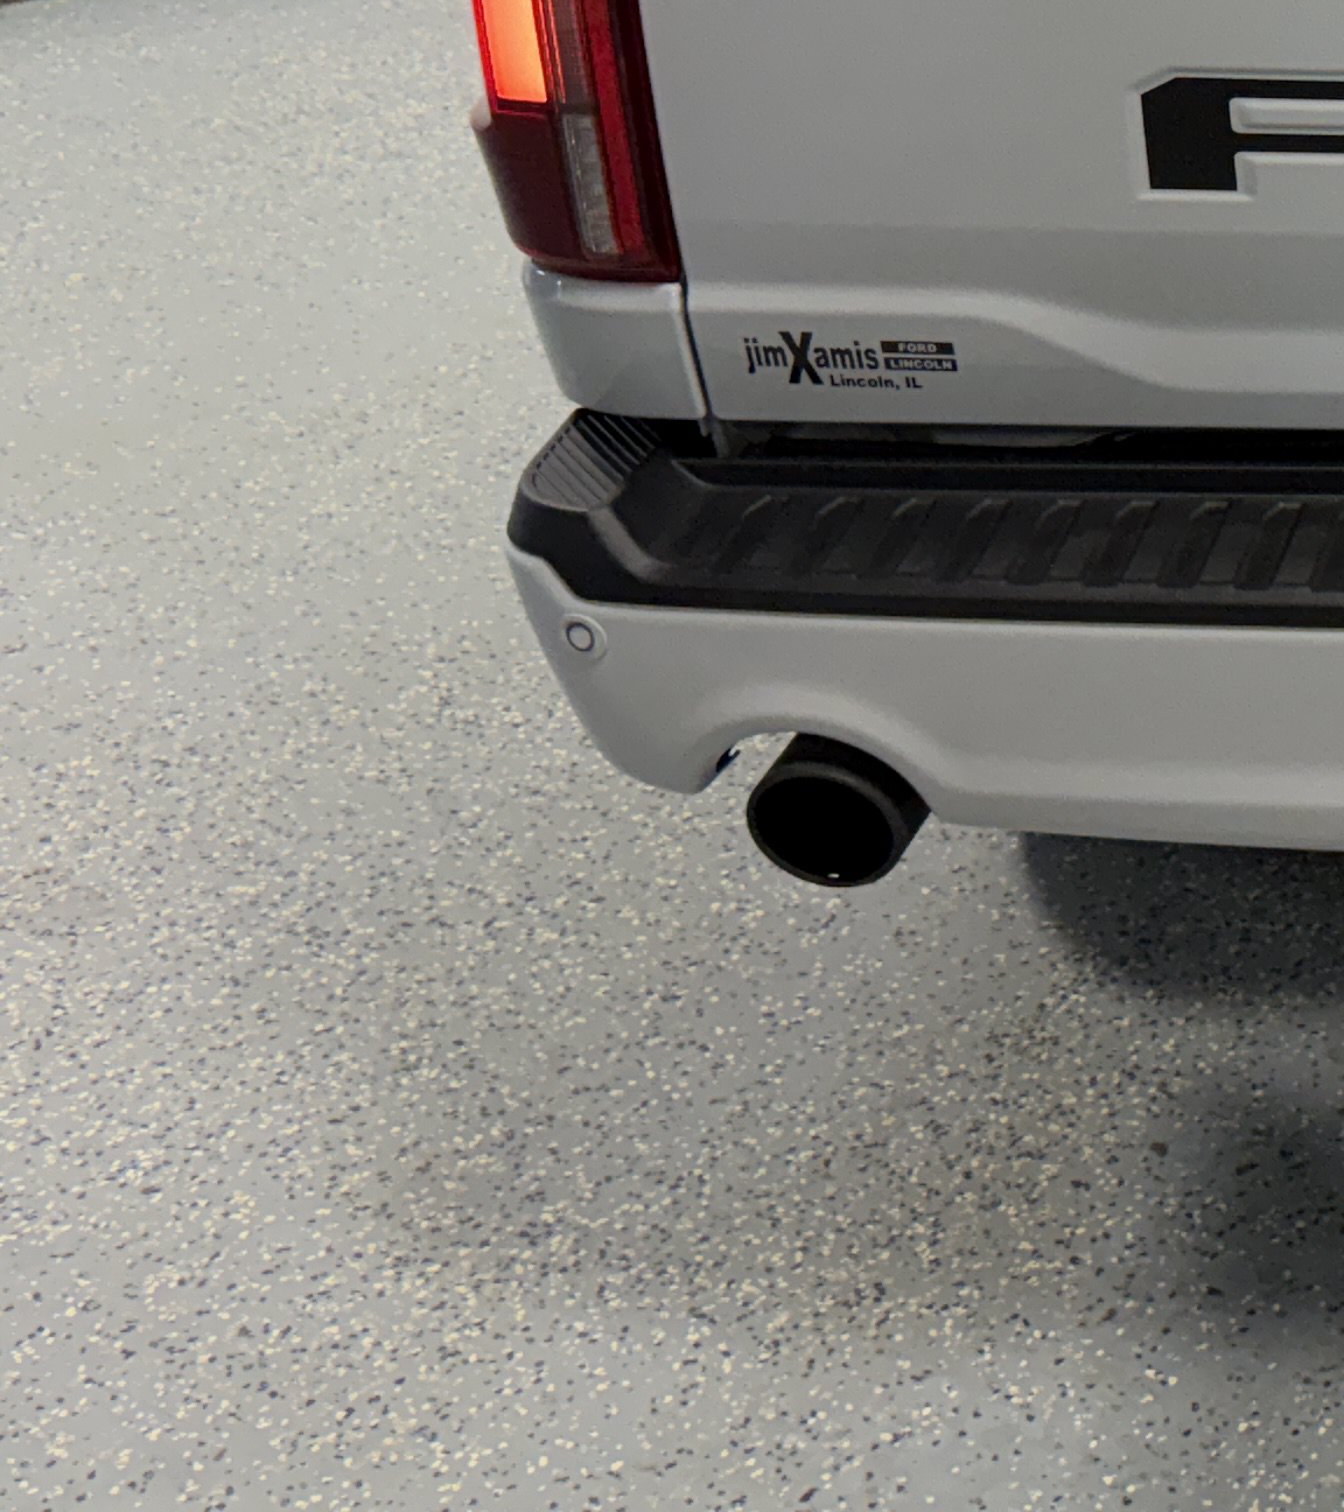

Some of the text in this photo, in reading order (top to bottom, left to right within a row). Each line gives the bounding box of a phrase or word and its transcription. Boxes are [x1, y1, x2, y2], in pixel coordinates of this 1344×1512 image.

[897, 343, 937, 353] FORD
[744, 331, 879, 385] jimXamis
[889, 358, 953, 370] LINCOLN
[829, 374, 923, 390] Lincoln, IL
